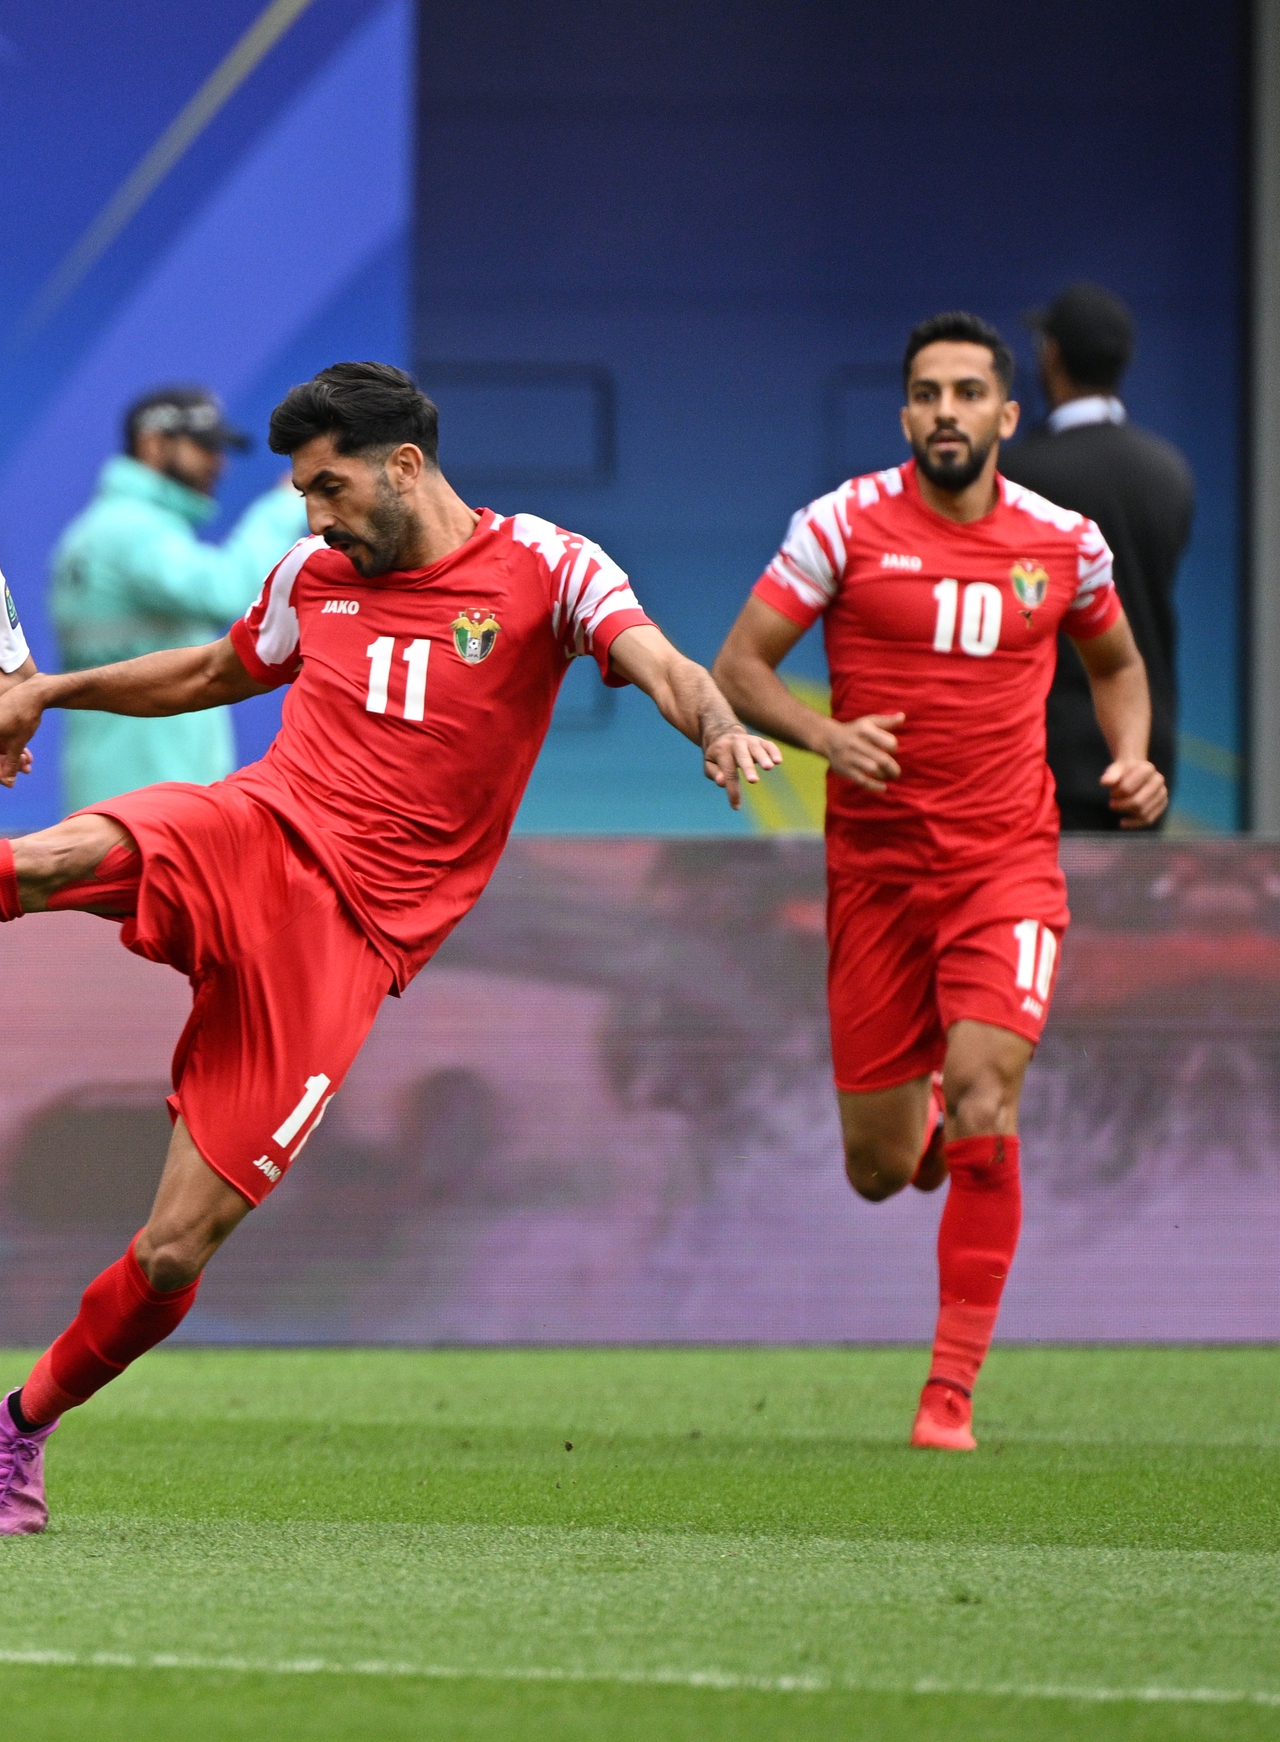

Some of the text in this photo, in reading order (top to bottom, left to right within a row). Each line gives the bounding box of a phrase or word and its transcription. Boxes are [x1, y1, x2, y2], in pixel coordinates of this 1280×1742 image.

[880, 552, 923, 572] JAKO
[321, 600, 360, 615] JAKO
[933, 577, 1003, 657] 10
[366, 636, 431, 722] 11
[271, 1072, 336, 1162] 1
